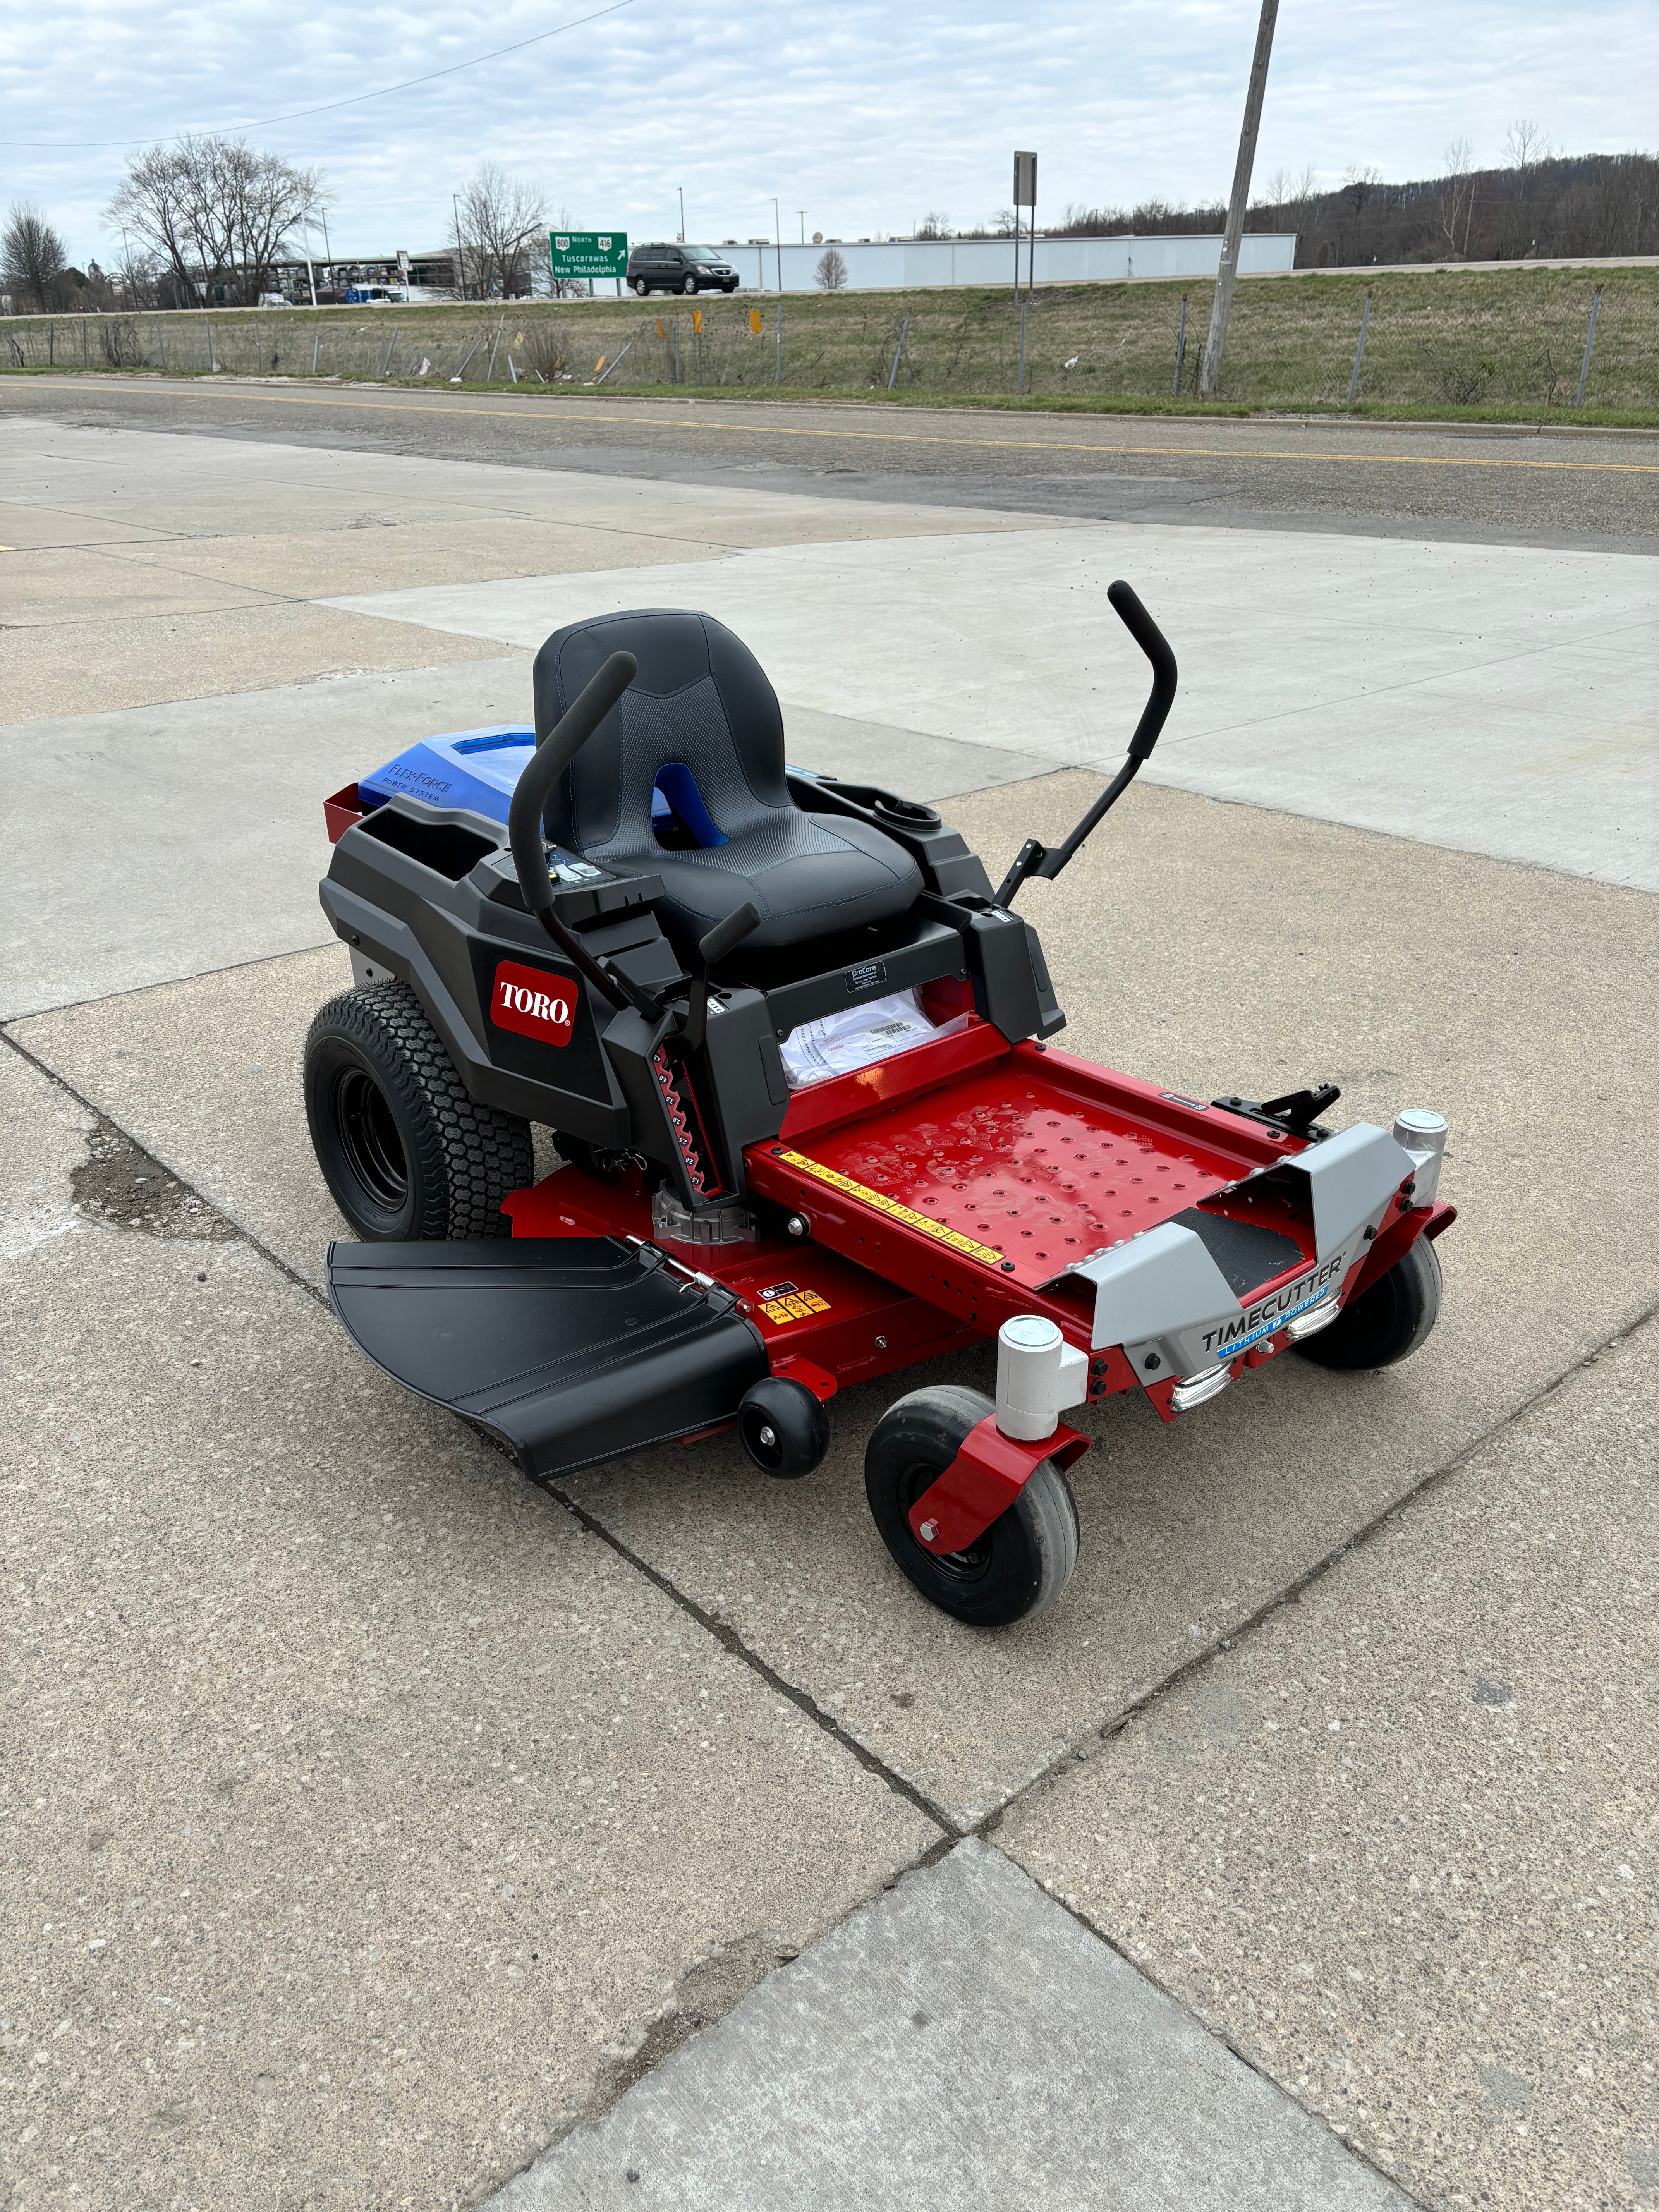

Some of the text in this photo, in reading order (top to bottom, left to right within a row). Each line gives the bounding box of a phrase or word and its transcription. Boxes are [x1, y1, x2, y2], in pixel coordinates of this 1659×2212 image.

[599, 239, 610, 247] 416
[573, 265, 617, 275] Philadelphia
[382, 778, 440, 802] POWER SYSTEM
[1224, 1289, 1325, 1355] LITHIUM POWERED
